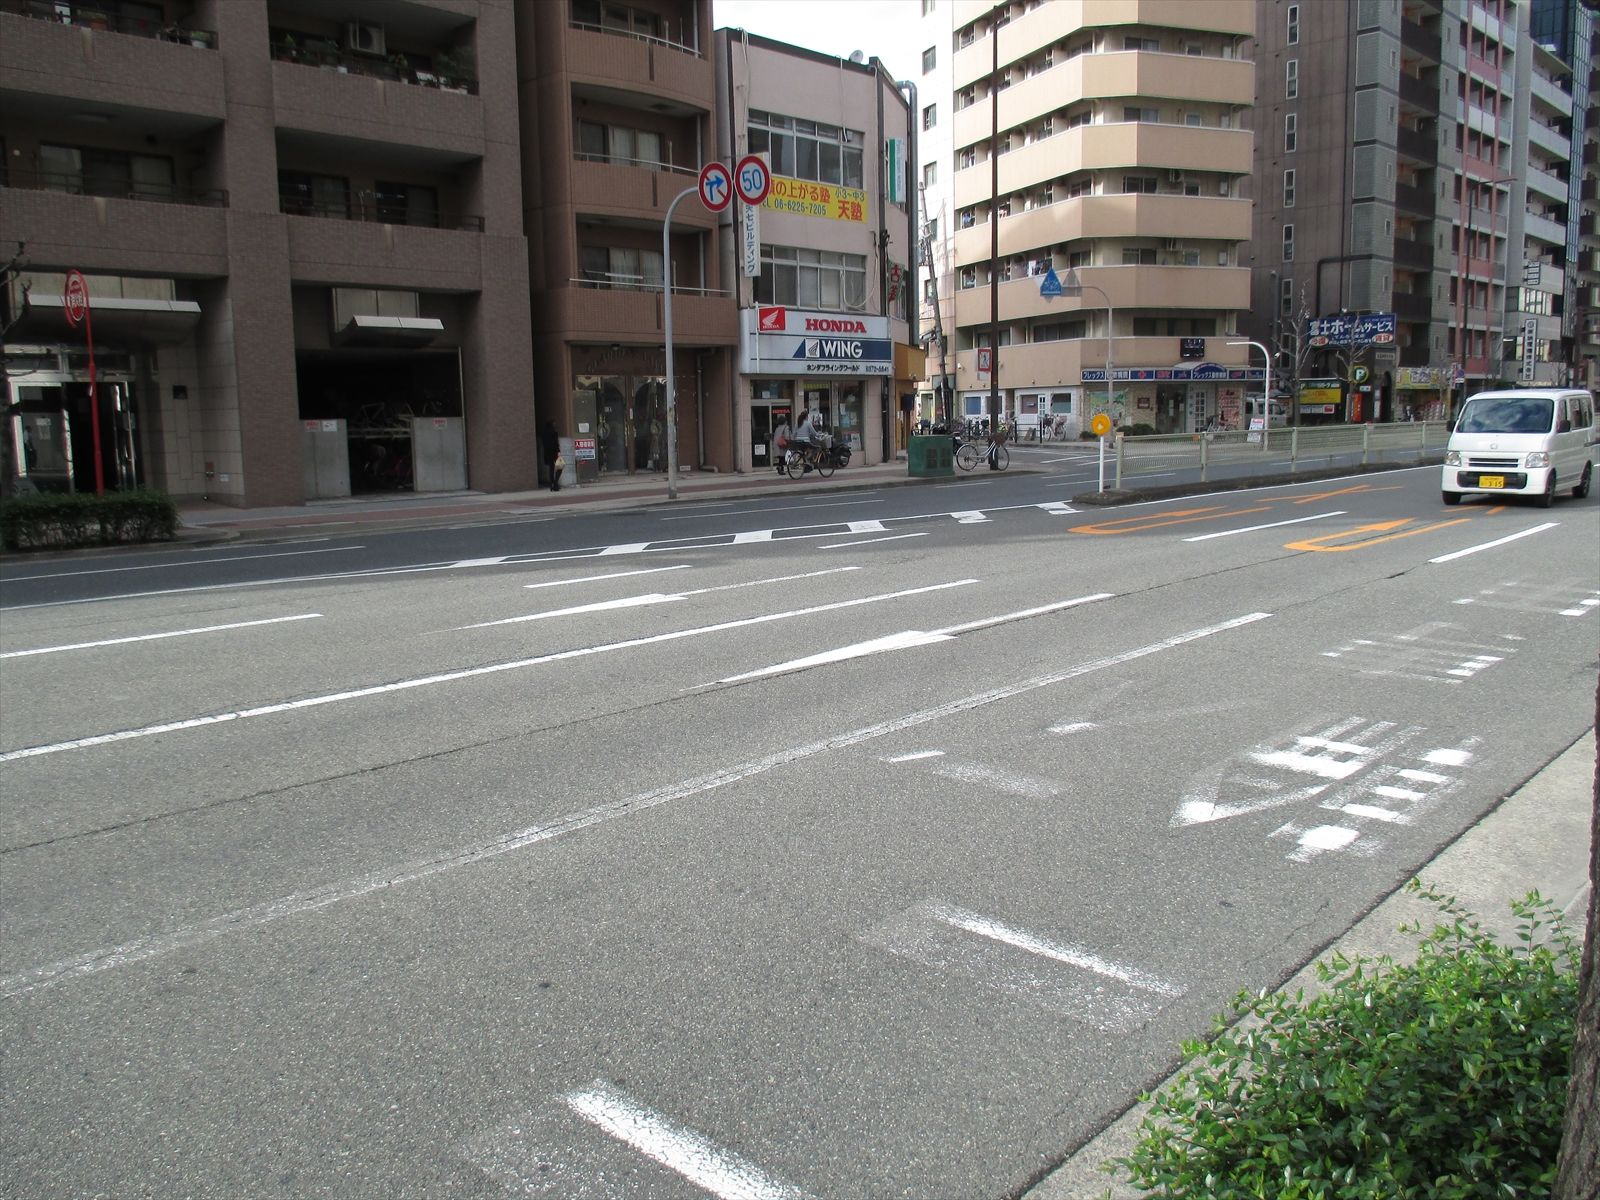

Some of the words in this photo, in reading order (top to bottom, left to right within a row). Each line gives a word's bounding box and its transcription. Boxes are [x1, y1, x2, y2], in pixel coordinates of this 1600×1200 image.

[742, 168, 762, 192] 50
[805, 318, 867, 334] HONDA
[821, 339, 863, 359] WING
